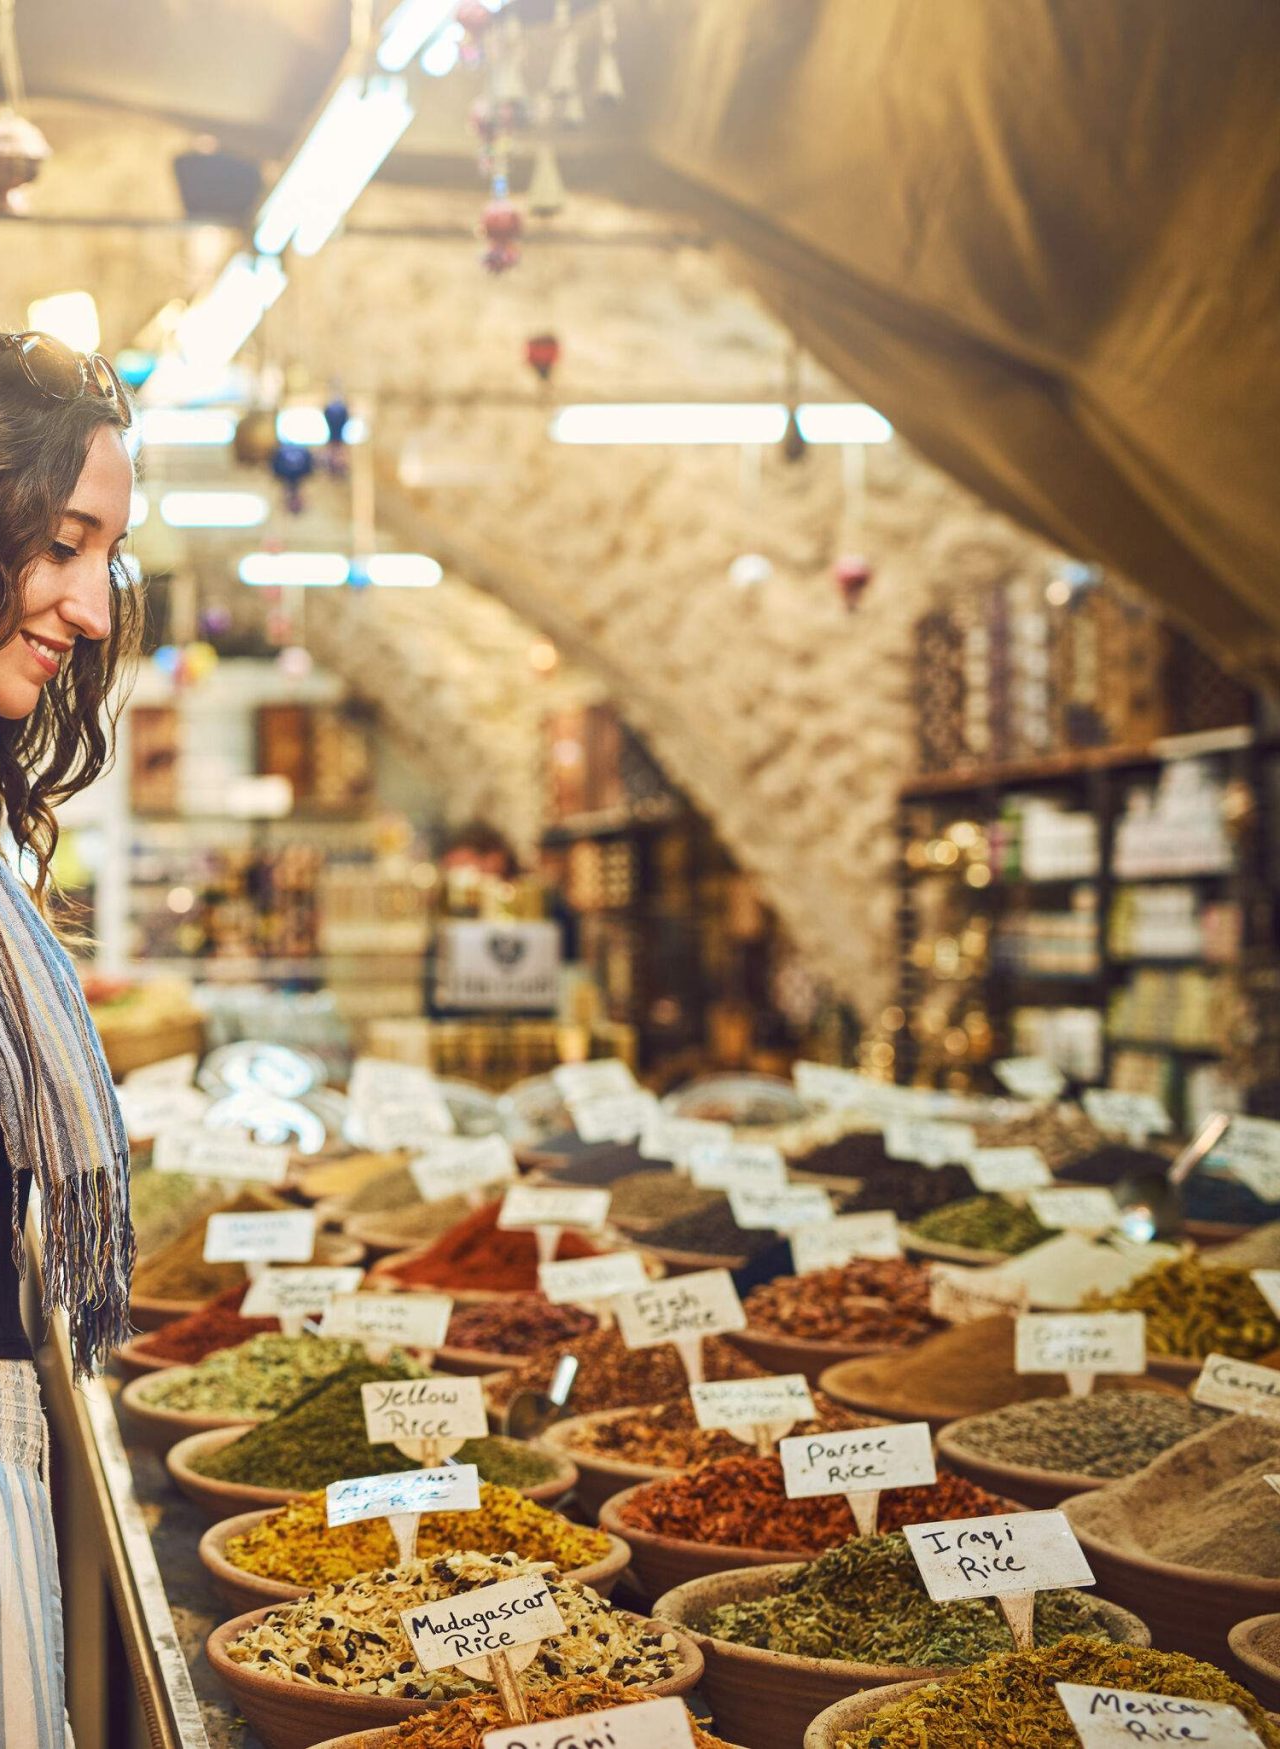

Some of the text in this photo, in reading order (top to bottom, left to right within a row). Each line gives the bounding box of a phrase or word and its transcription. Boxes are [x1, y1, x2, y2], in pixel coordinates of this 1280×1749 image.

[1035, 1344, 1116, 1364] Coffee
[370, 1383, 458, 1413] Yellow
[383, 1410, 453, 1437] Rice
[806, 1439, 894, 1467] Parsee
[827, 1464, 886, 1483] Rice
[921, 1522, 1014, 1554] Iraqi
[957, 1555, 1026, 1582] Rice
[411, 1590, 548, 1639] Madagascar
[443, 1631, 516, 1658] Rice
[1089, 1692, 1213, 1718] Mexican
[1125, 1720, 1210, 1742] Rice
